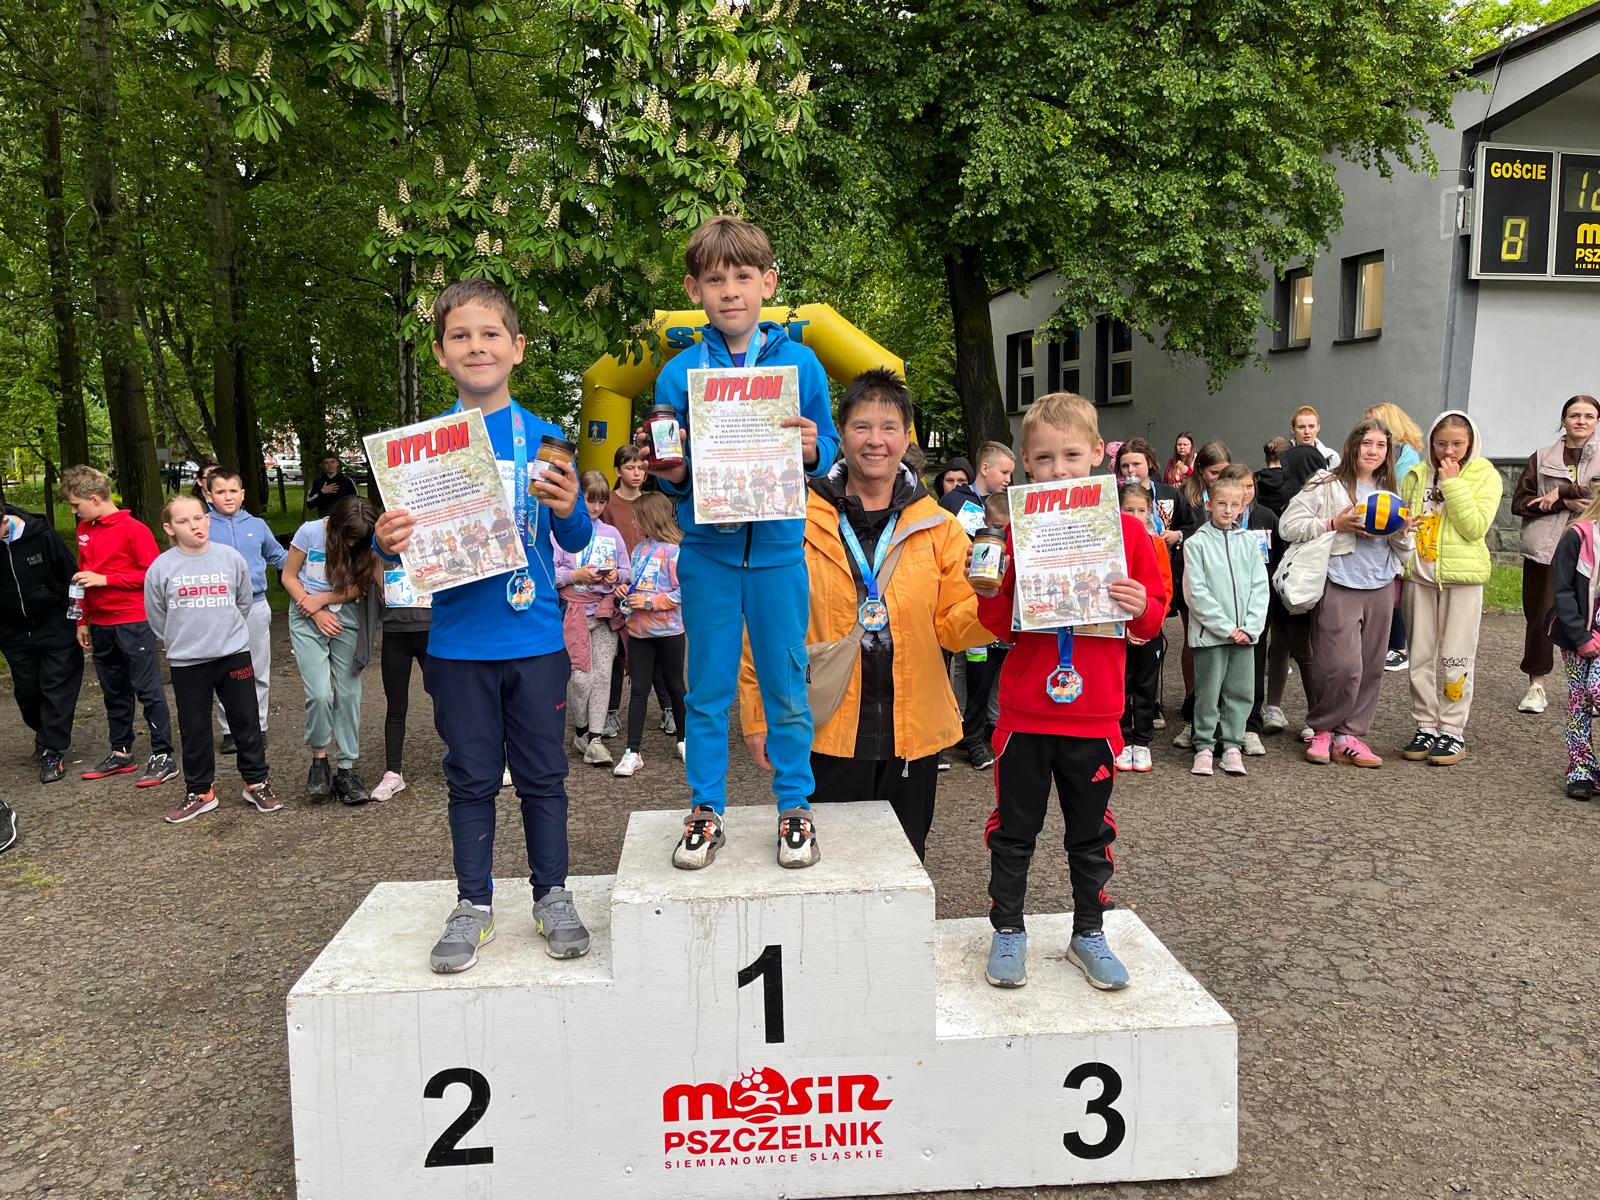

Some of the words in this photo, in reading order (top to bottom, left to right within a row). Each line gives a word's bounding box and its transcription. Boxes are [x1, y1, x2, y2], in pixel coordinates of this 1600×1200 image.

[1490, 160, 1547, 180] GOŚCIE
[1501, 218, 1526, 260] 8
[703, 375, 784, 402] DYPLOM
[386, 421, 470, 469] DYPLOM
[1024, 483, 1102, 515] DYPLOM
[172, 571, 229, 587] street
[178, 585, 228, 597] dance
[738, 944, 785, 1044] 1
[423, 1067, 494, 1168] 2
[1063, 1062, 1126, 1160] 3
[664, 1121, 884, 1156] PSZCZELNIK
[664, 1153, 799, 1169] SIEMIANOWICE
